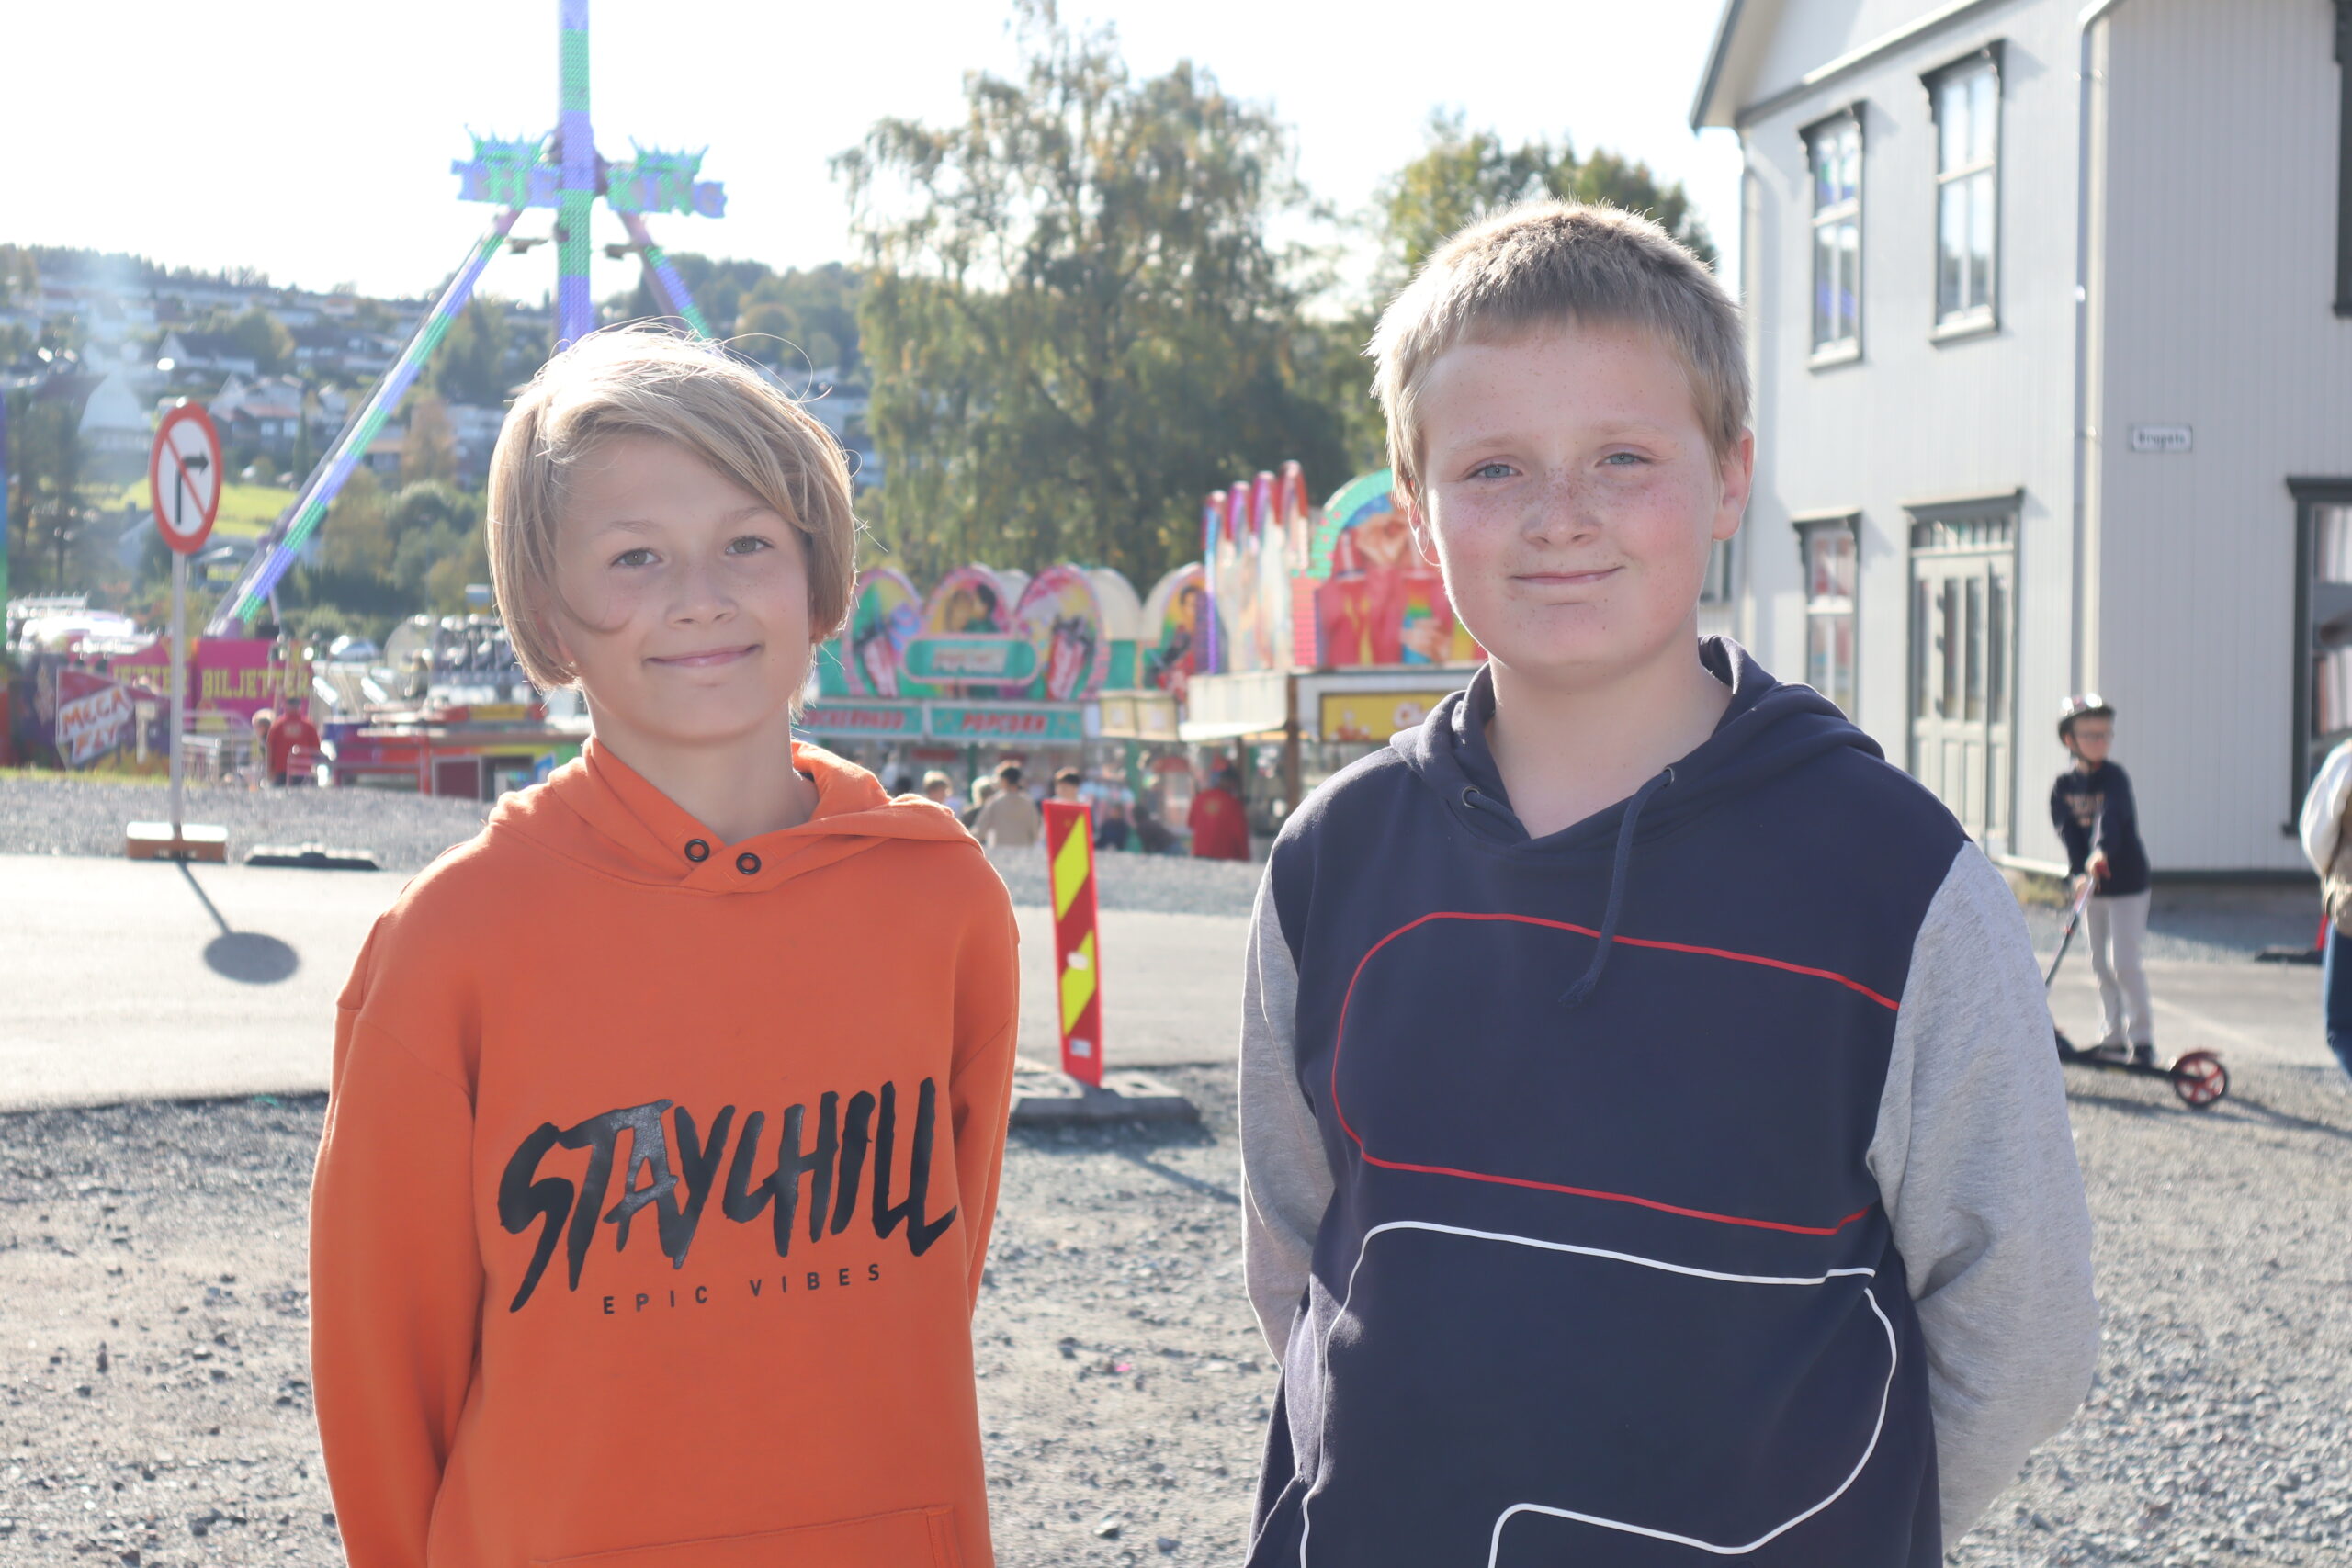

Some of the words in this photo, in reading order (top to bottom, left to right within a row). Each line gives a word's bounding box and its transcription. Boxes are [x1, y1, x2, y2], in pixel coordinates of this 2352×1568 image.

[961, 711, 1047, 733] POPCORN
[603, 1285, 708, 1314] EPIC
[749, 1263, 880, 1297] VIBES
